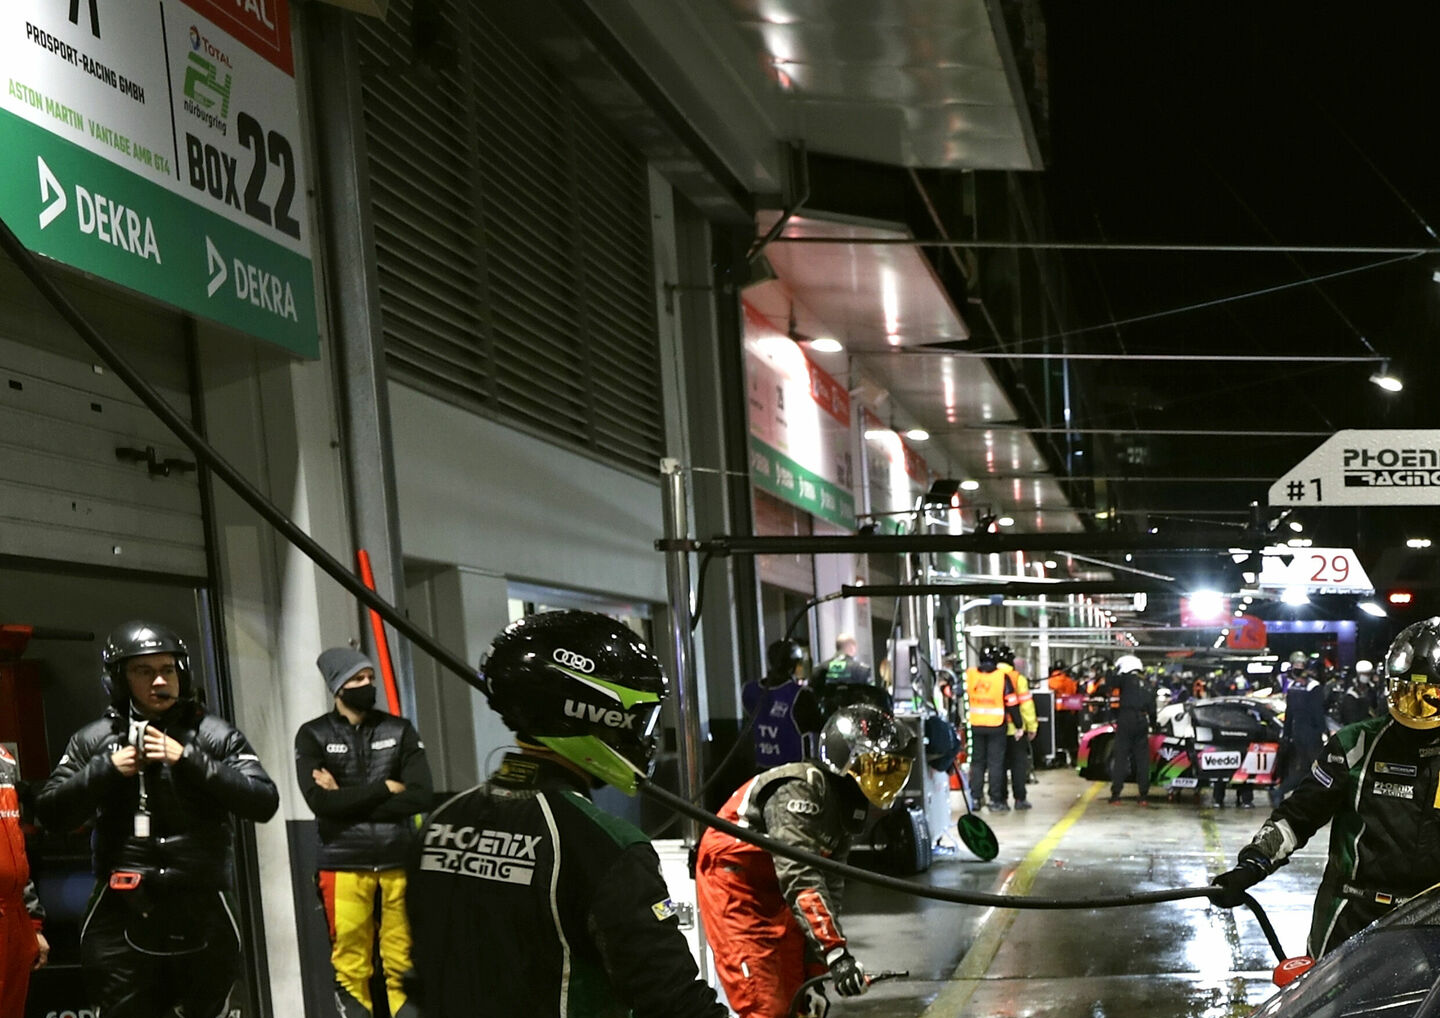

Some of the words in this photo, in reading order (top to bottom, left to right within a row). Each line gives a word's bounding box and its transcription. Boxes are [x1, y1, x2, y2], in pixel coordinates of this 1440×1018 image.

[25, 21, 117, 89] PROSPORT-RACING
[119, 75, 146, 104] GMBH
[202, 36, 233, 69] TOTAL
[9, 78, 43, 111] ASTON
[45, 96, 84, 131] MARTIN
[88, 119, 131, 157] VANTAGE
[133, 142, 153, 167] AMR
[186, 131, 242, 211] BOX
[237, 111, 301, 241] 22
[75, 184, 162, 265] DEKRA
[233, 257, 299, 323] DEKRA
[1287, 478, 1323, 502] #1
[1310, 555, 1350, 583] 29
[563, 699, 638, 730] uvex
[758, 725, 779, 739] TV
[1204, 755, 1239, 766] Veedol
[1257, 753, 1267, 771] 11
